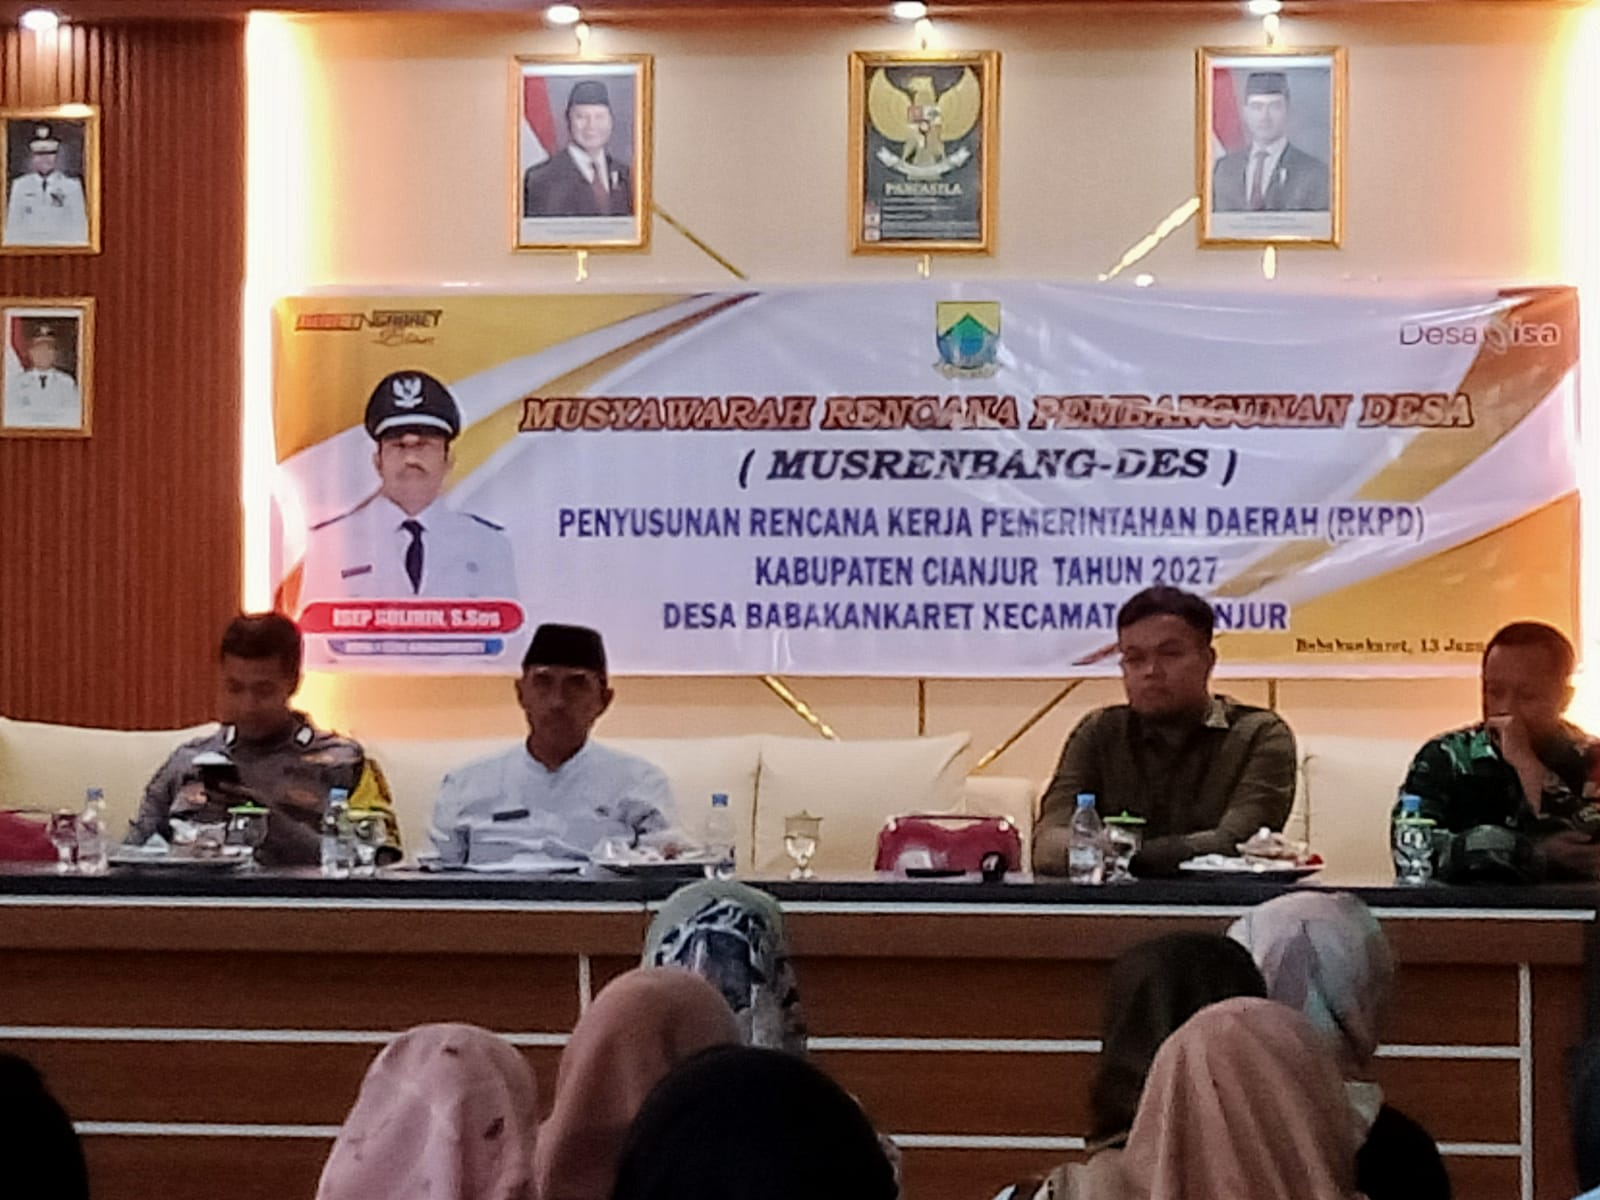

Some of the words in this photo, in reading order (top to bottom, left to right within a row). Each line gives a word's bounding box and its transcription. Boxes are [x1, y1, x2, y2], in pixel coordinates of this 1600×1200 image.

[520, 396, 816, 431] MUSYAWARAH
[820, 395, 1019, 431] RENCANA
[1029, 394, 1353, 429] PEMBANGUNAN
[1357, 393, 1474, 428] DESA
[767, 448, 1208, 480] MUSRENBANG-DES
[559, 507, 741, 537] PENYUSUNAN
[750, 507, 879, 537] RENCANA
[887, 507, 973, 537] KERJA
[982, 507, 1196, 537] PEMERINTAHAN
[1206, 507, 1319, 536] DAERAH
[1327, 506, 1425, 541] (RKPD)
[755, 556, 912, 587] KABUPATEN
[922, 556, 1037, 586] CIANJUR
[1053, 556, 1142, 586] TAHUN
[1152, 556, 1219, 586] 2027
[663, 603, 736, 630] DESA
[746, 602, 973, 630] BABAKANKARET
[982, 603, 1116, 630] KECAMAT
[1213, 603, 1287, 630] NJUR
